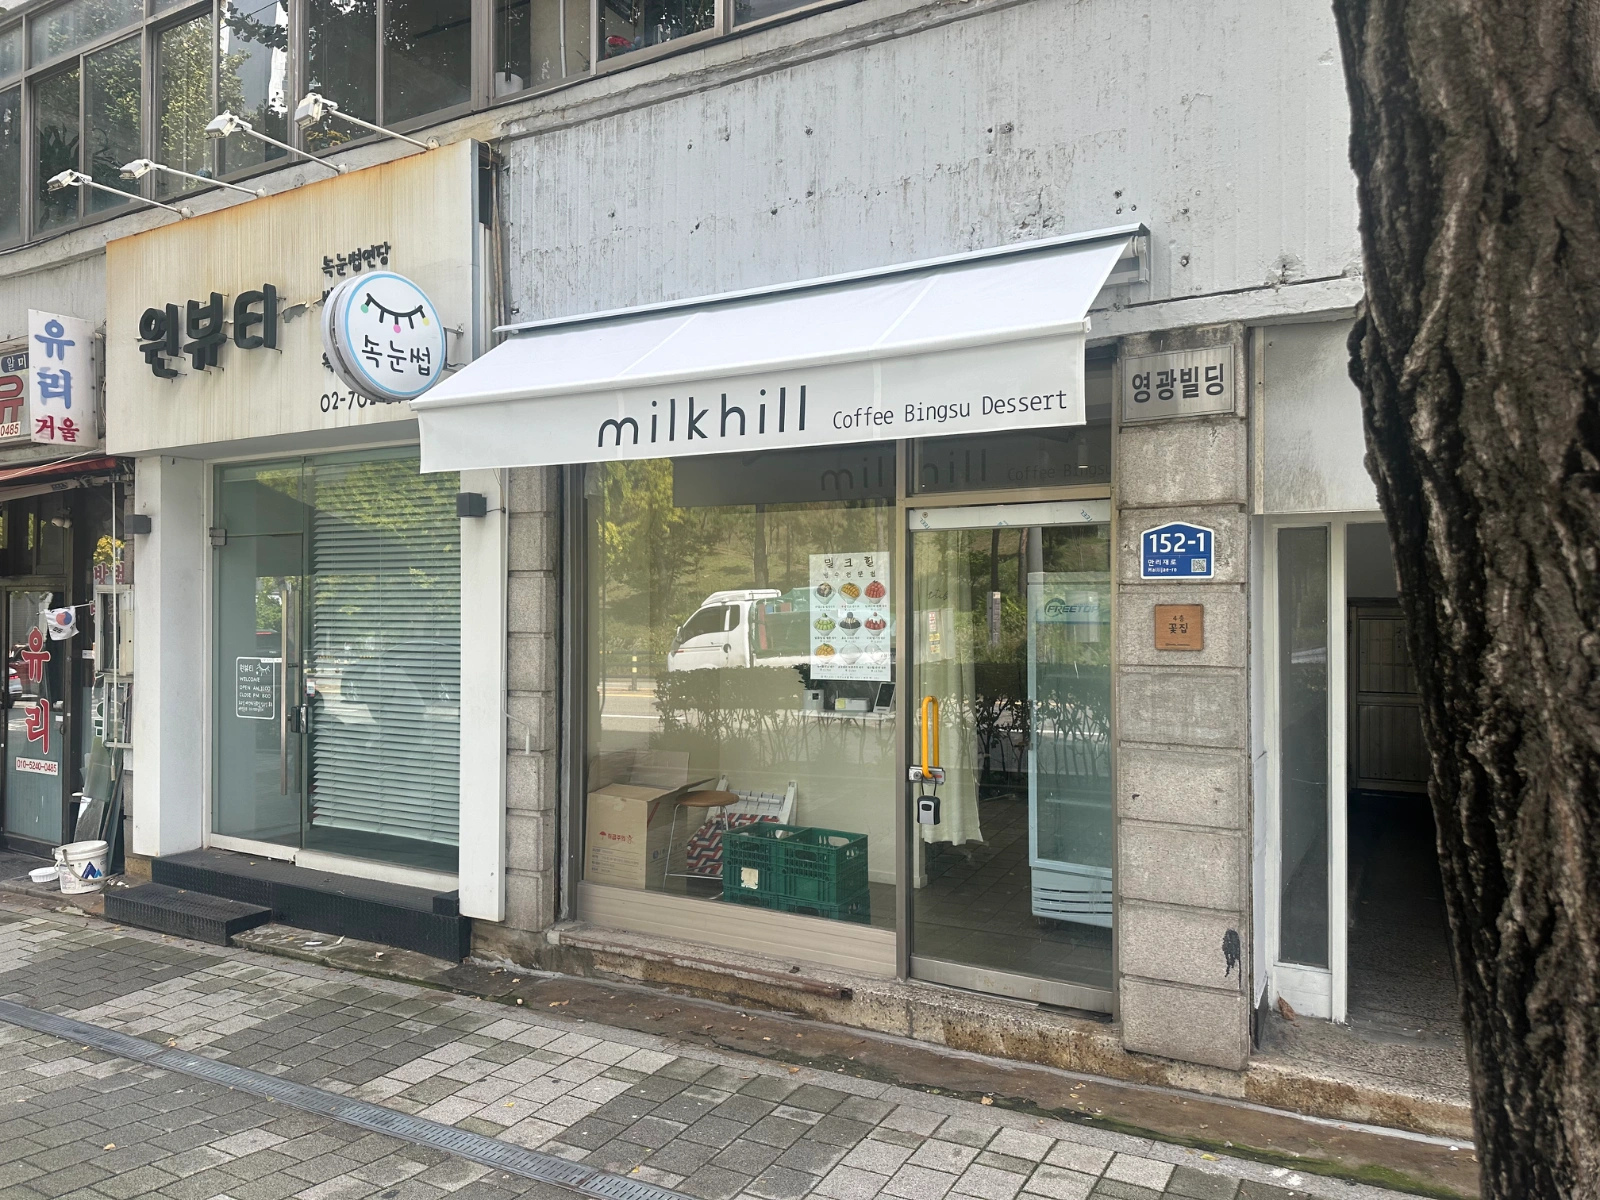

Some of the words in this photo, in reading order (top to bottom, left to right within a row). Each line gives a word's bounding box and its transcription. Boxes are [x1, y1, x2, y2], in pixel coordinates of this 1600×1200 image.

[139, 283, 277, 378] 원뷰티
[34, 319, 76, 410] 유리
[361, 334, 431, 376] 속눈썹
[1131, 363, 1224, 404] 영광빌딩
[35, 415, 80, 442] 거울
[597, 385, 807, 448] milkhill
[833, 406, 894, 429] Coffee
[904, 401, 971, 423] Bingsu
[982, 390, 1067, 415] Dessert
[1147, 559, 1177, 567] 만리재로
[1149, 532, 1205, 553] 152-1
[1168, 622, 1188, 634] 꽃집
[21, 626, 51, 755] 유리
